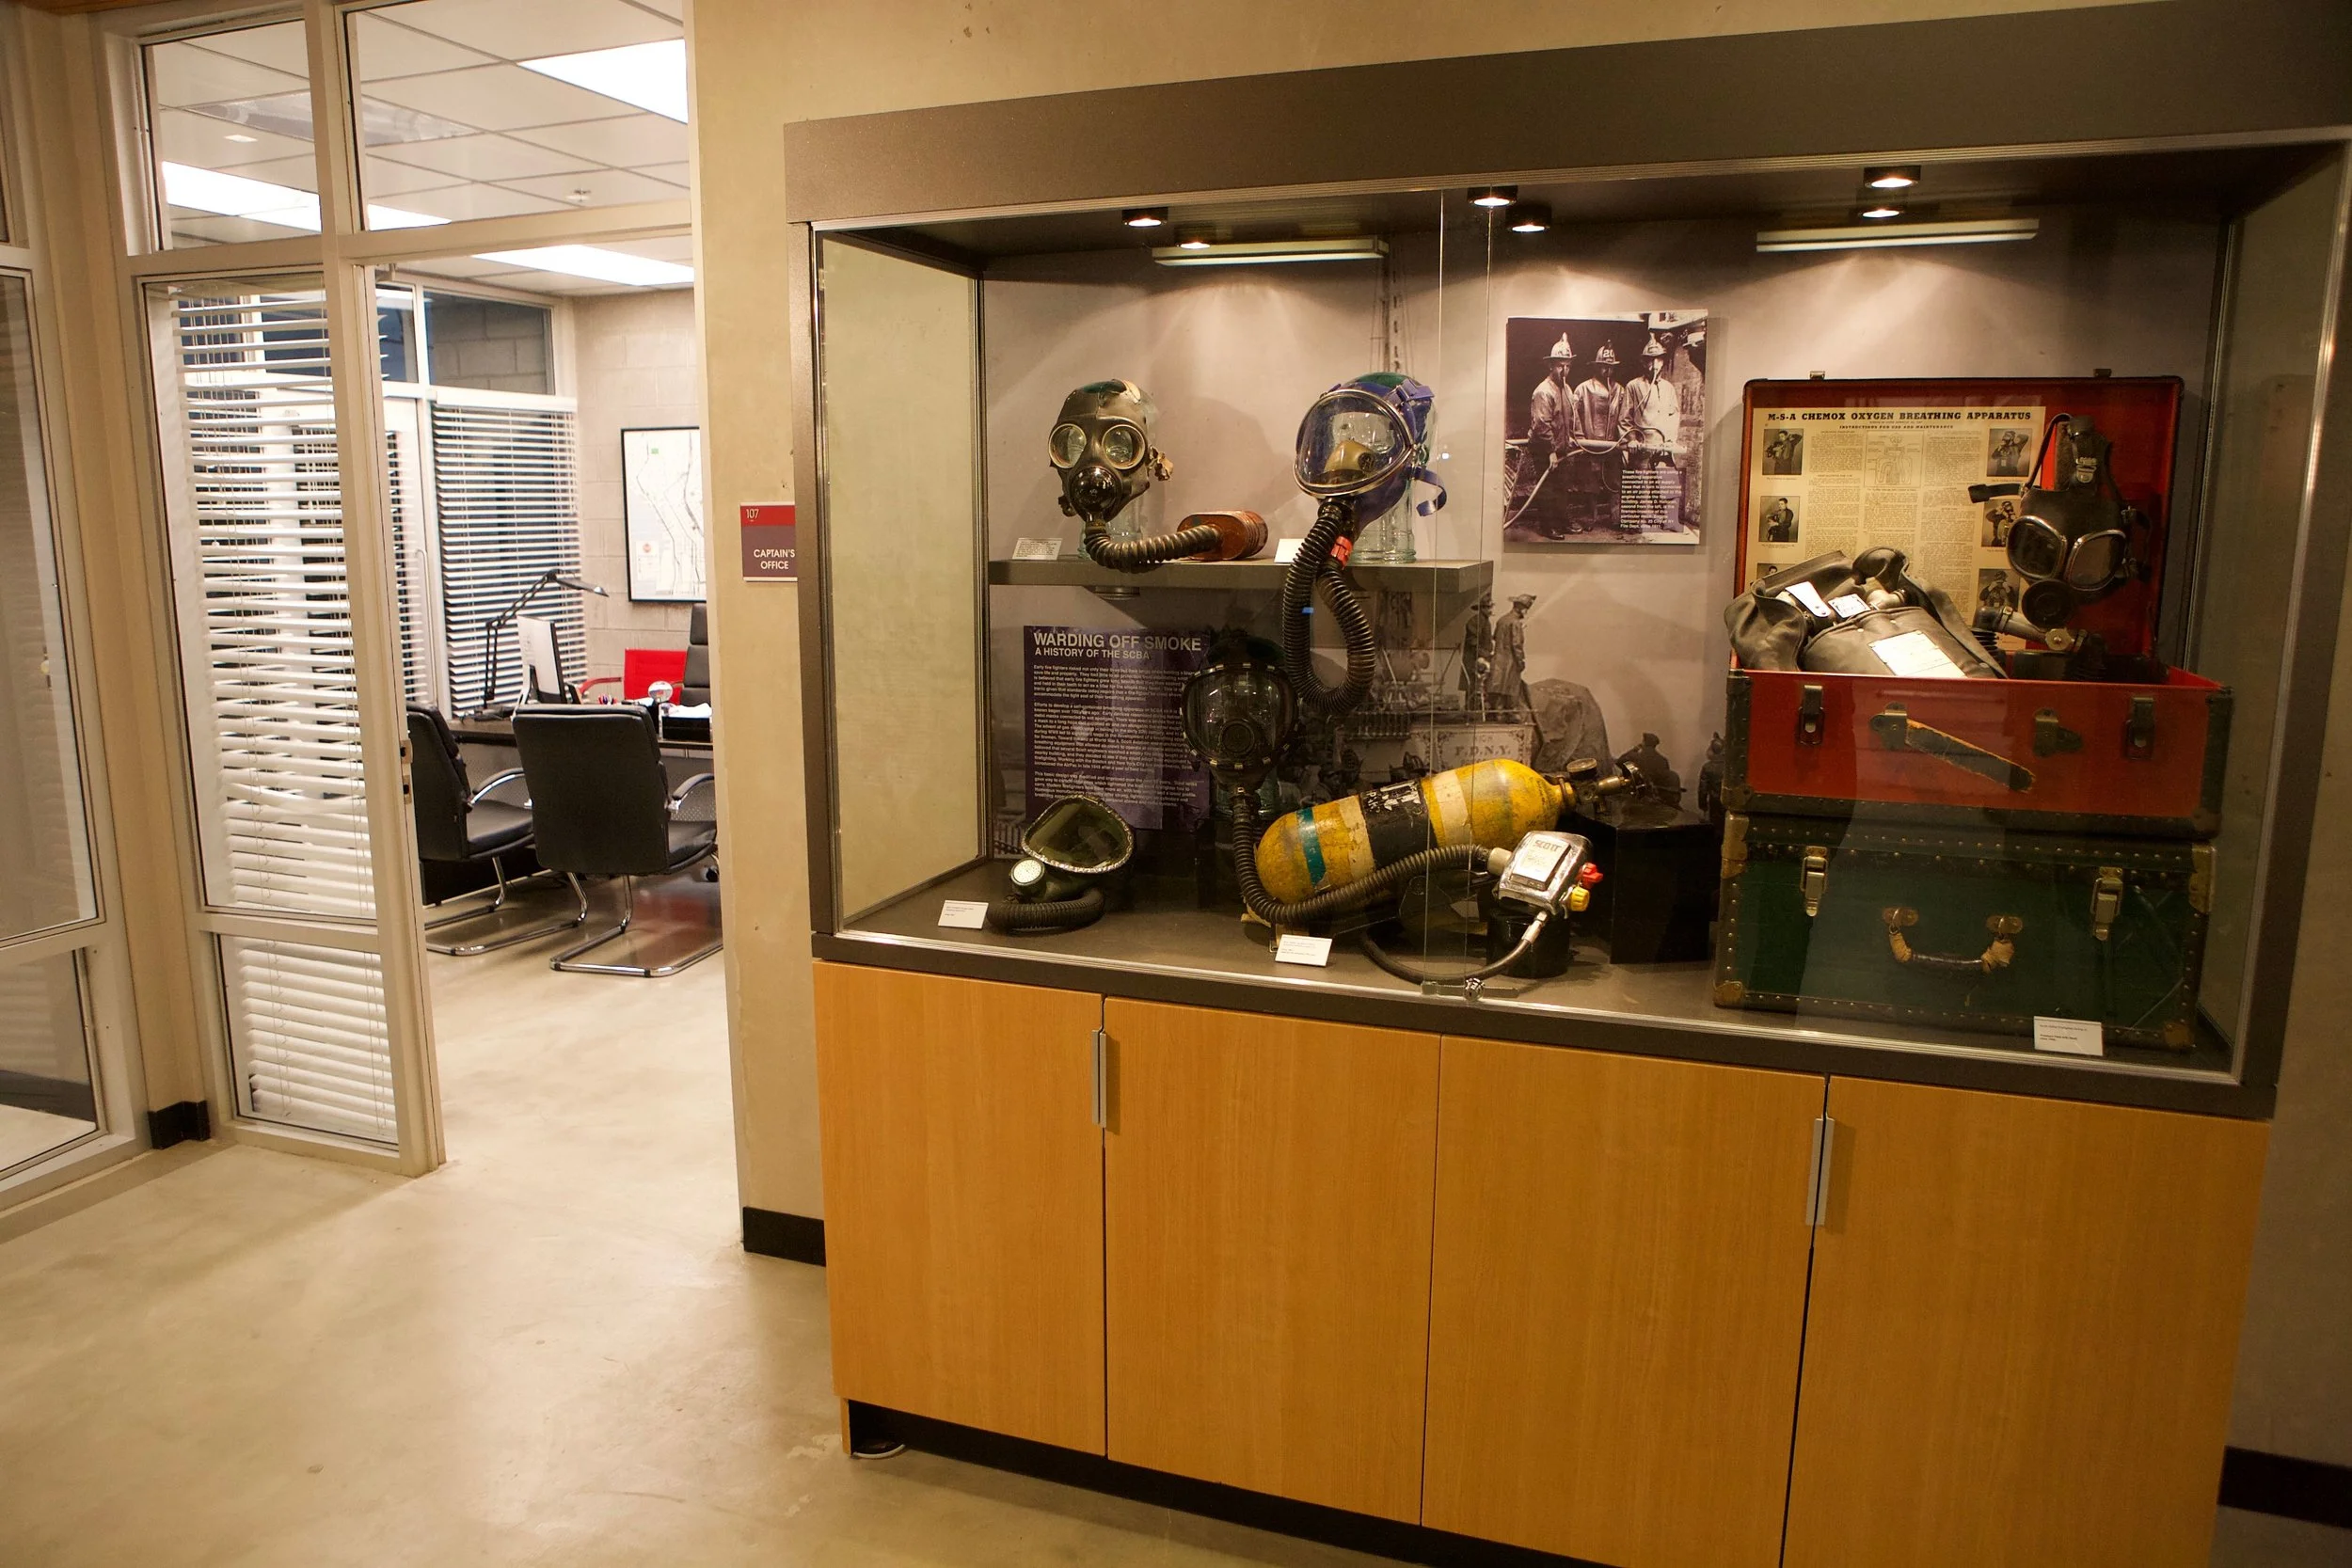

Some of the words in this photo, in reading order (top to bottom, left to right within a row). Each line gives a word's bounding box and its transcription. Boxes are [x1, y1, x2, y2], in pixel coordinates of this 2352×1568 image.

[1851, 412, 1894, 420] OXYGEN
[1899, 412, 1961, 420] BREATHING
[746, 509, 759, 519] 107
[754, 549, 796, 558] CAPTAIN'S
[760, 561, 789, 569] OFFICE
[1034, 632, 1104, 647] WARDING
[1109, 635, 1139, 648] OFF
[1144, 636, 1201, 651] SMOKE
[1043, 648, 1084, 657] HISTORY
[1086, 649, 1099, 657] OF
[1102, 649, 1120, 658] THE
[1122, 650, 1150, 659] SCBA
[1534, 839, 1562, 852] SCOTT
